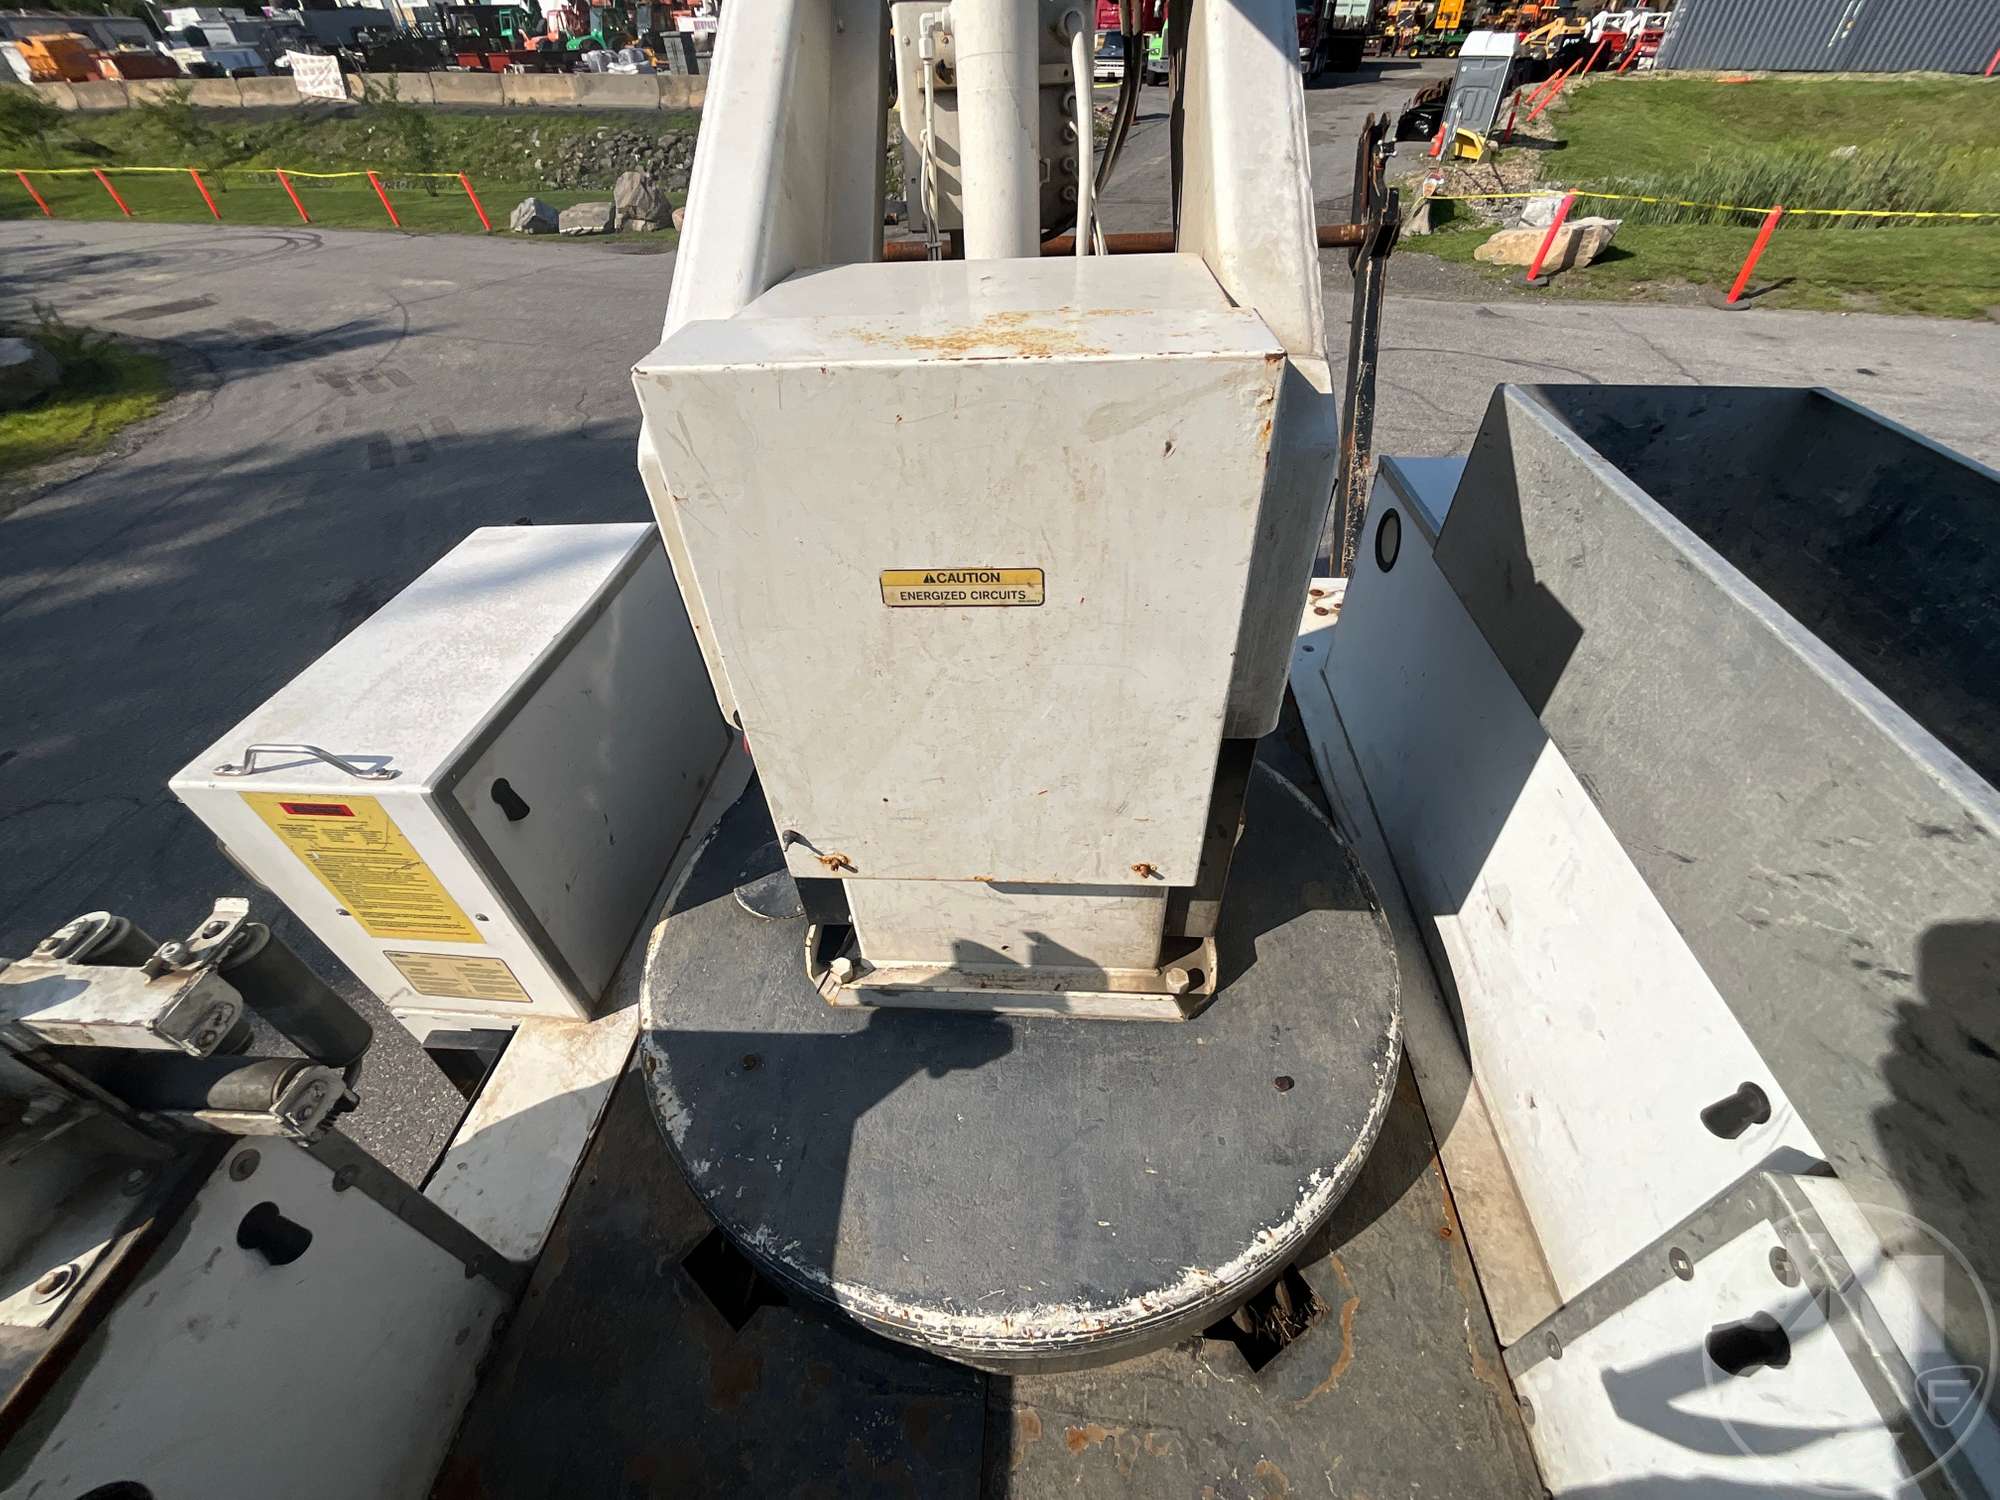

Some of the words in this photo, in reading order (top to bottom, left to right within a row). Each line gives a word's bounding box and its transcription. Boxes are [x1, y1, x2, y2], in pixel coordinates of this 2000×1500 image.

[936, 572, 1001, 584] CAUTION
[900, 590, 967, 601] ENERGIZED
[970, 590, 1026, 600] CIRCUITS
